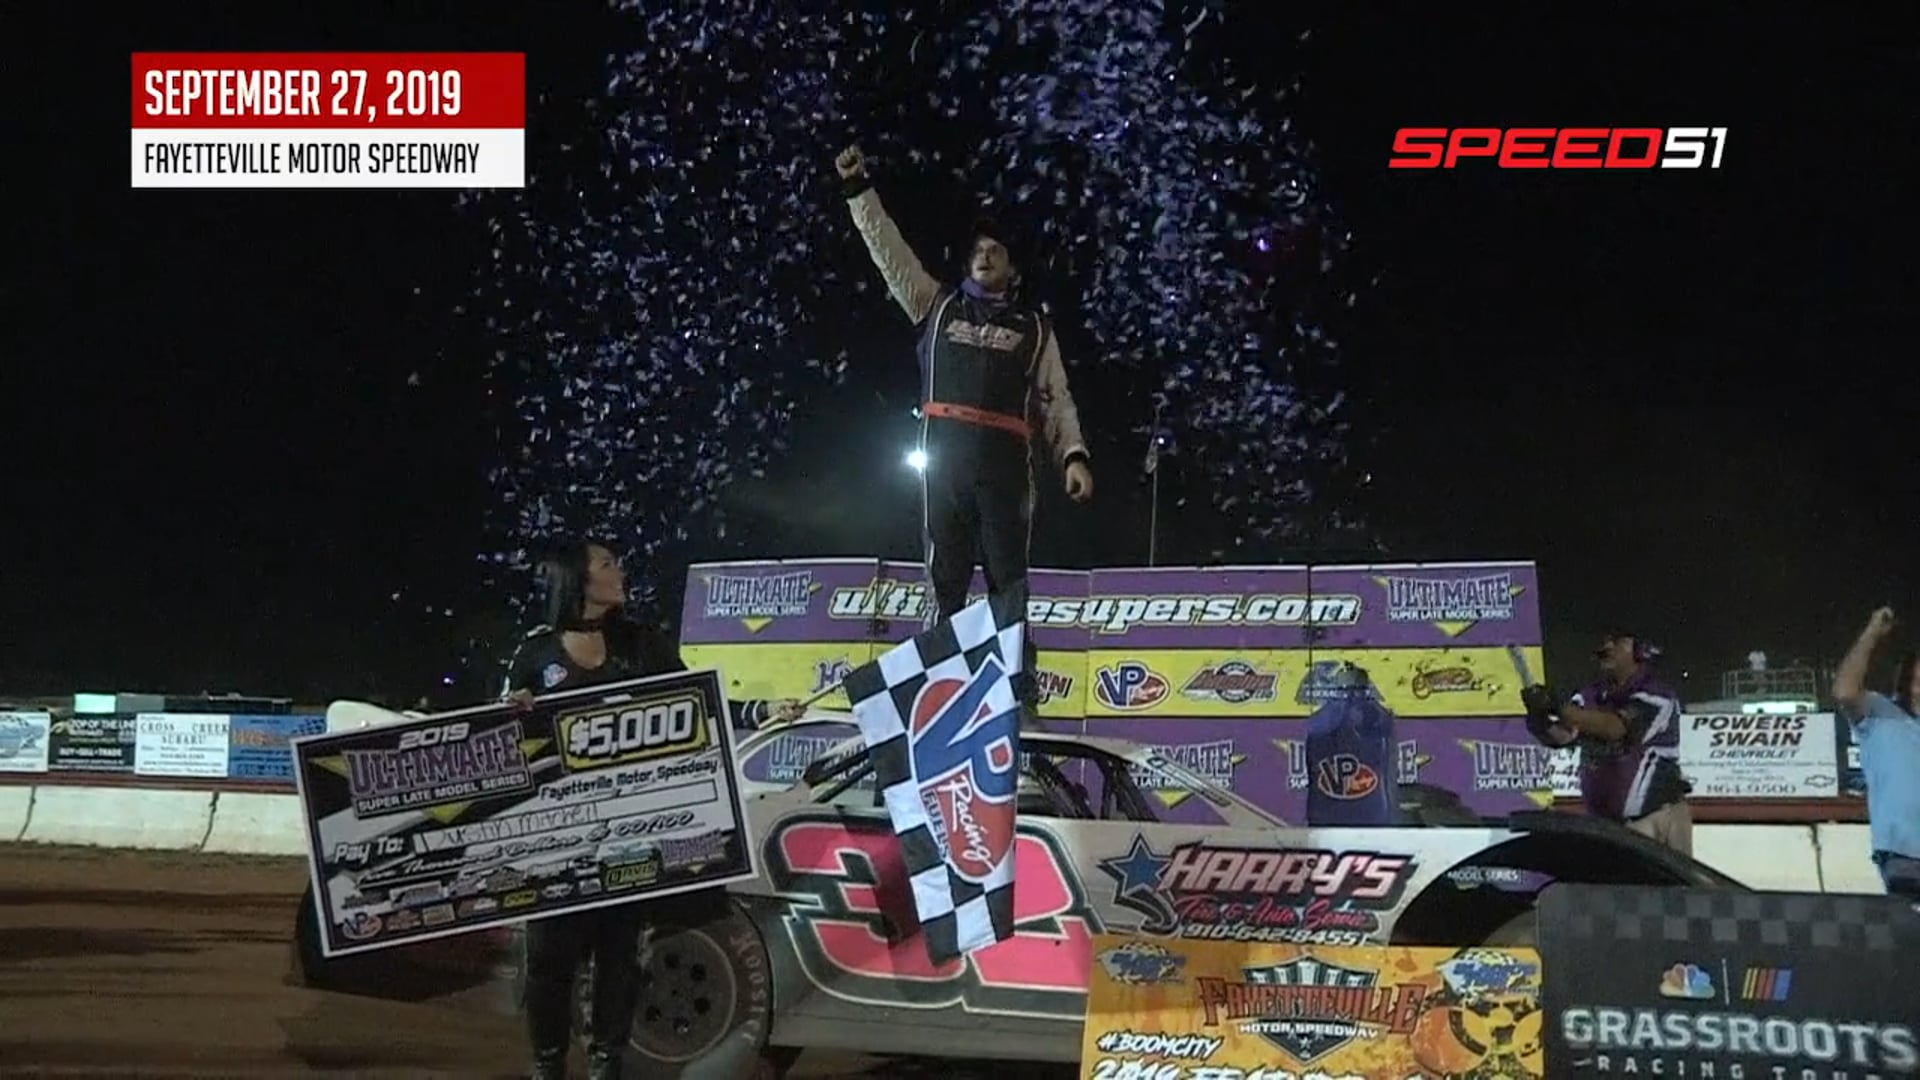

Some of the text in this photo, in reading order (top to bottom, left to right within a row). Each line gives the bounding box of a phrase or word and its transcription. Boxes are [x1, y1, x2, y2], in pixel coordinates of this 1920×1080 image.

[707, 571, 812, 606] ULTIMATE
[1388, 573, 1512, 609] ULTIMATE
[707, 606, 806, 617] SUPER LATE MODEL SERIES
[1390, 609, 1511, 620] SUPER LATE MODEL SERIES
[1101, 666, 1145, 706] VP
[140, 722, 228, 733] CROSS CREEK
[162, 734, 206, 745] SUBARU
[397, 721, 471, 750] 2019
[569, 700, 695, 758] $5,000
[1692, 716, 1806, 731] POWERS
[1710, 732, 1803, 747] SWAIN
[342, 720, 527, 795] ULTIMATE
[1710, 749, 1800, 759] CHEVROLET
[541, 759, 719, 800] Fayetteville Motor Speedway
[1319, 754, 1359, 797] VP
[358, 773, 527, 813] SUPER LATE MODEL SERIES
[920, 789, 951, 860] FUELS
[937, 773, 997, 872] Racing
[332, 836, 406, 865] Pay To:
[1160, 846, 1412, 901] HARRY'S
[1176, 896, 1219, 923] Tire
[1246, 898, 1296, 925] Auto
[1198, 976, 1428, 1035] FAYETTEVILLE
[1098, 1030, 1222, 1058] #BOOMCITY
[1239, 1022, 1378, 1039] MOTOR SPEEDWAY
[1561, 1009, 1919, 1069] GRASSROOTS
[1597, 1056, 1745, 1079] RACING
